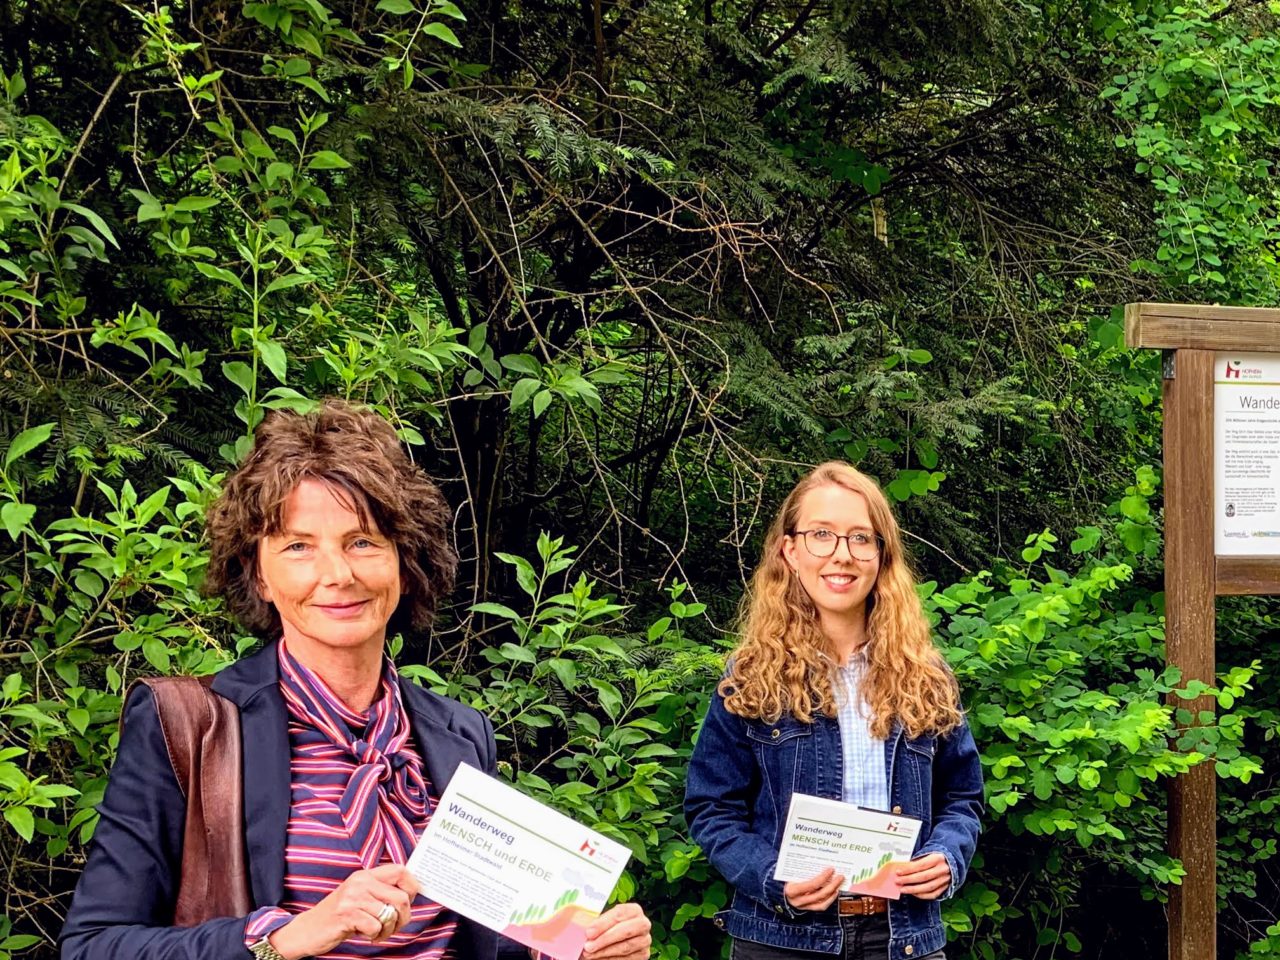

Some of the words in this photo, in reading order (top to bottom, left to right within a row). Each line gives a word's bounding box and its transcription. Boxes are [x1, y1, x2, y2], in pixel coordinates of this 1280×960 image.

[448, 802, 516, 845] Wanderweg
[794, 823, 843, 839] Wanderweg
[439, 818, 494, 853] MENSCH
[494, 846, 518, 865] und
[518, 858, 554, 883] ERDE
[791, 833, 830, 847] MENSCH
[831, 842, 848, 850] und
[849, 844, 873, 854] ERDE
